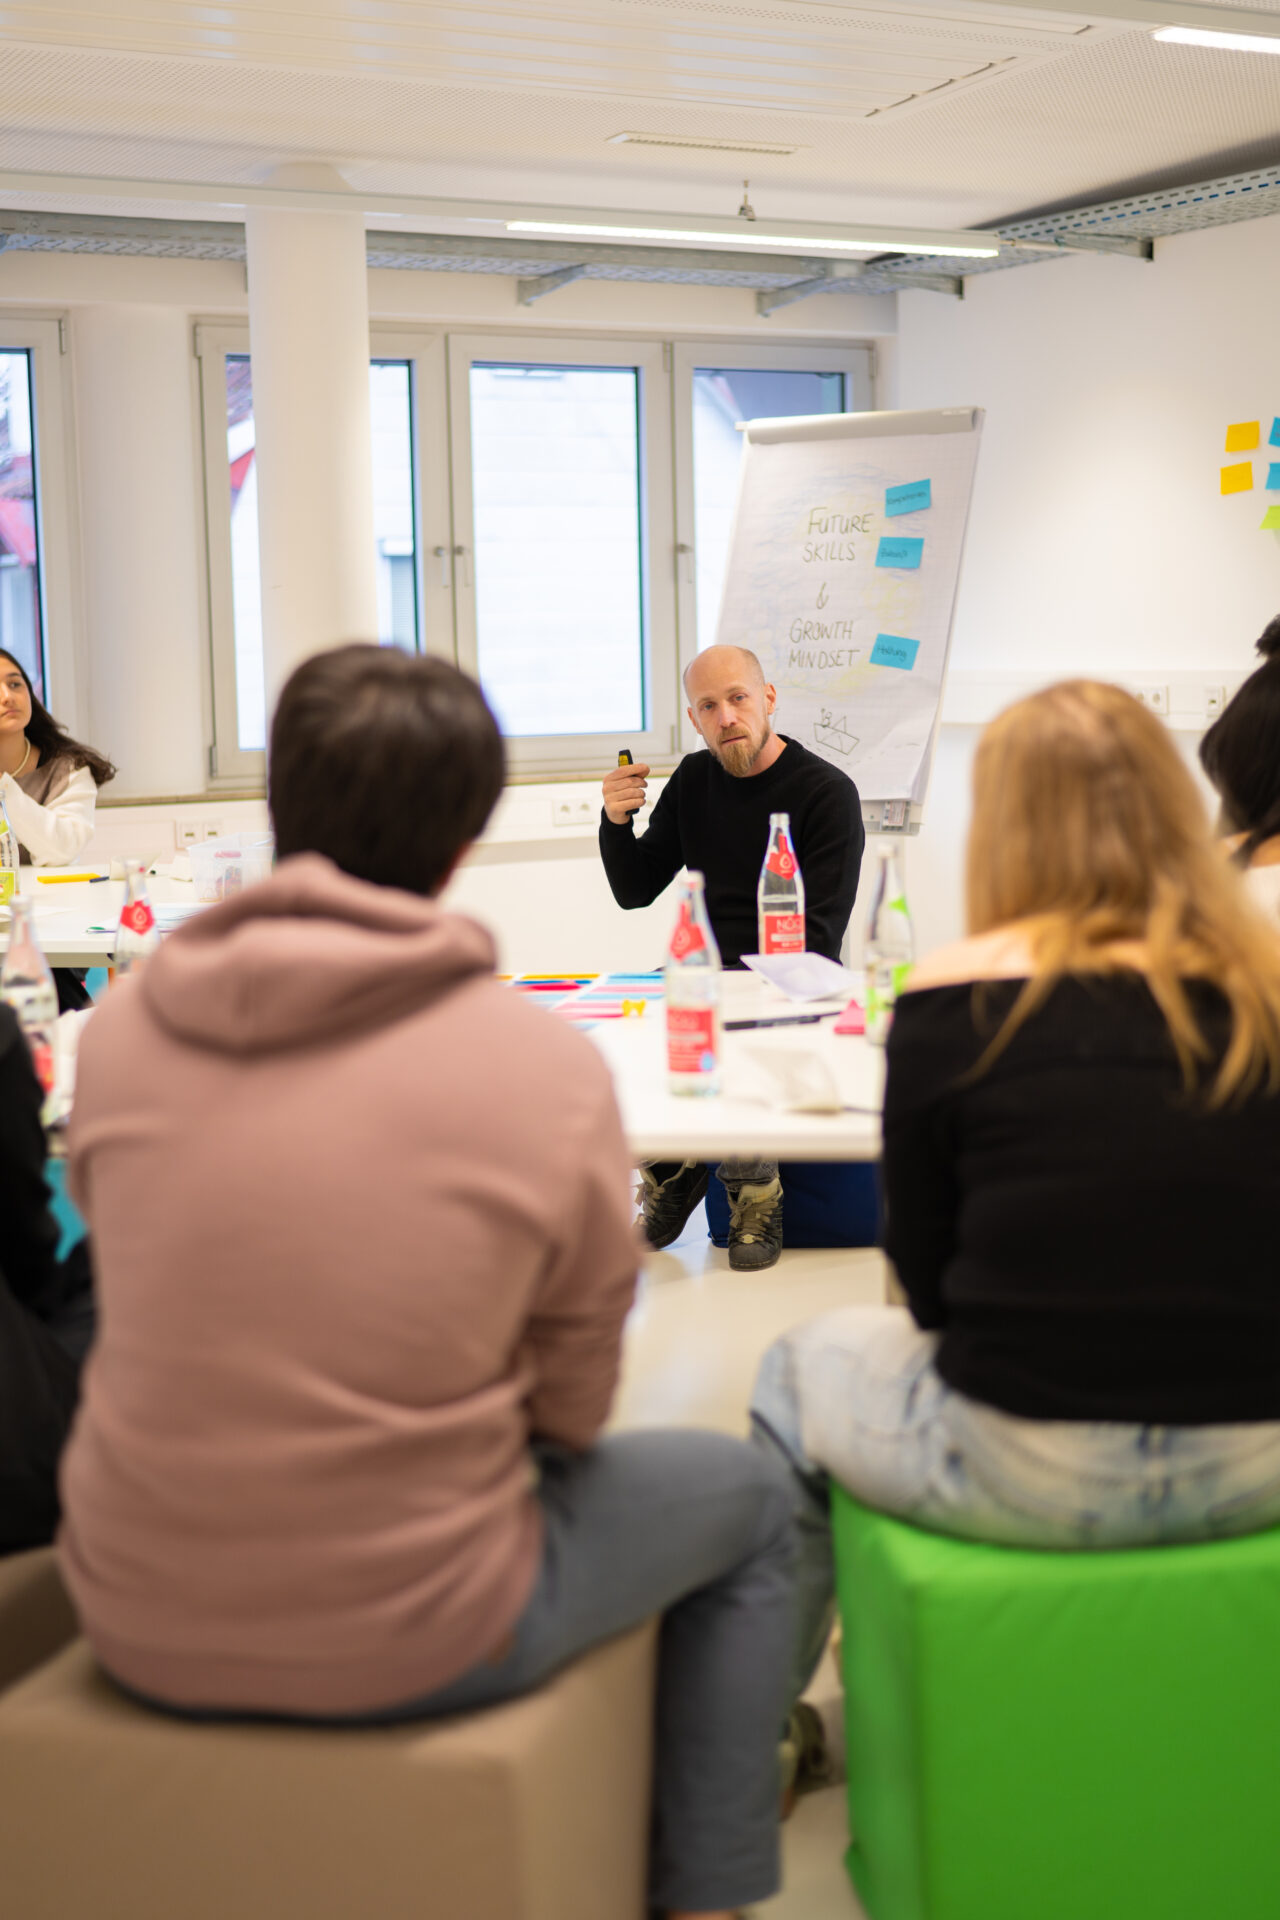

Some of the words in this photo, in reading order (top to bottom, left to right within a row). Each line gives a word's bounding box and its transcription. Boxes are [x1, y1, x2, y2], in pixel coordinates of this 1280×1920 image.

[807, 506, 875, 535] FUTURE
[802, 542, 856, 563] SKILLS
[789, 618, 854, 643] GROWTH
[788, 649, 861, 670] MINDSET
